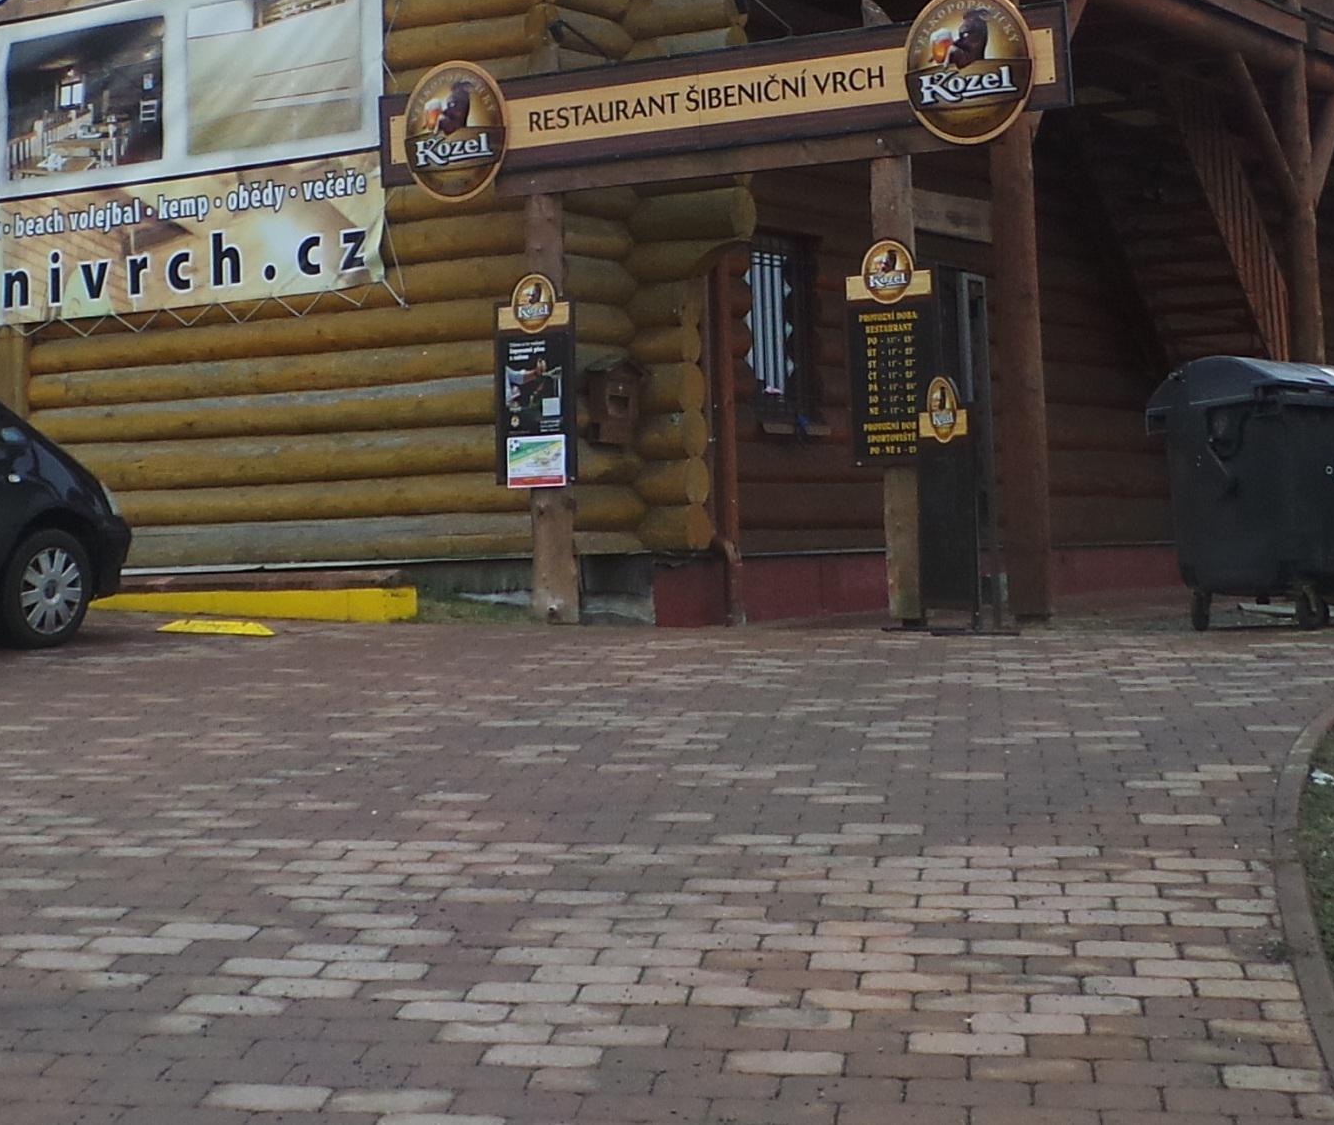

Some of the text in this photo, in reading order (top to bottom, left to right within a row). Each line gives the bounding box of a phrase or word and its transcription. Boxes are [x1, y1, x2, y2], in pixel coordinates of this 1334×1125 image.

[528, 65, 885, 133] RESTAURANT ŠIBENIČNÍ VRCH
[919, 65, 1017, 104] Kozel
[415, 133, 493, 166] Kozel
[13, 208, 65, 238] beach
[68, 199, 140, 234] volejbal
[157, 193, 209, 221] kemp
[227, 181, 284, 212] obědy
[302, 172, 367, 202] večeře
